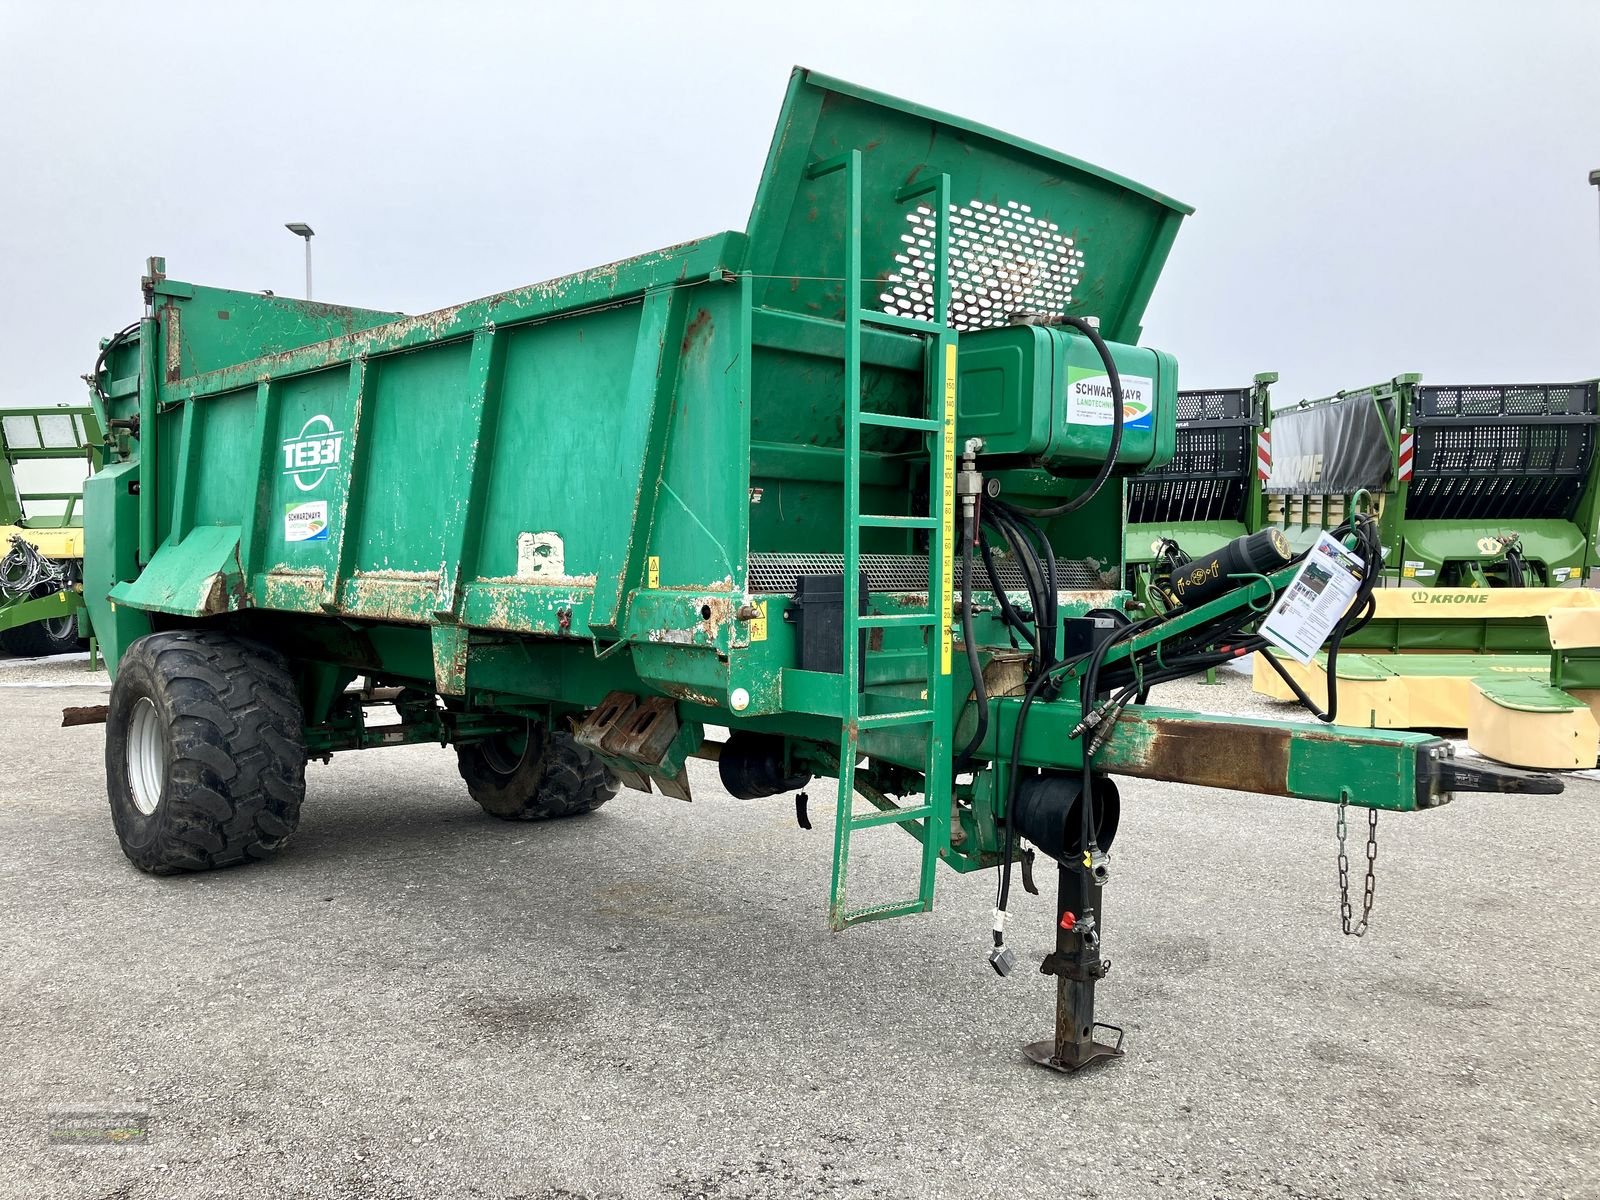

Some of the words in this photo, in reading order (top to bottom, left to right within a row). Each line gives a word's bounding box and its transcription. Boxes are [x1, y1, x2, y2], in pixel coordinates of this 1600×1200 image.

[1075, 383, 1141, 401] SCHWARMAYR
[1076, 398, 1114, 409] LANDTECHNI
[1430, 594, 1489, 604] KRONE
